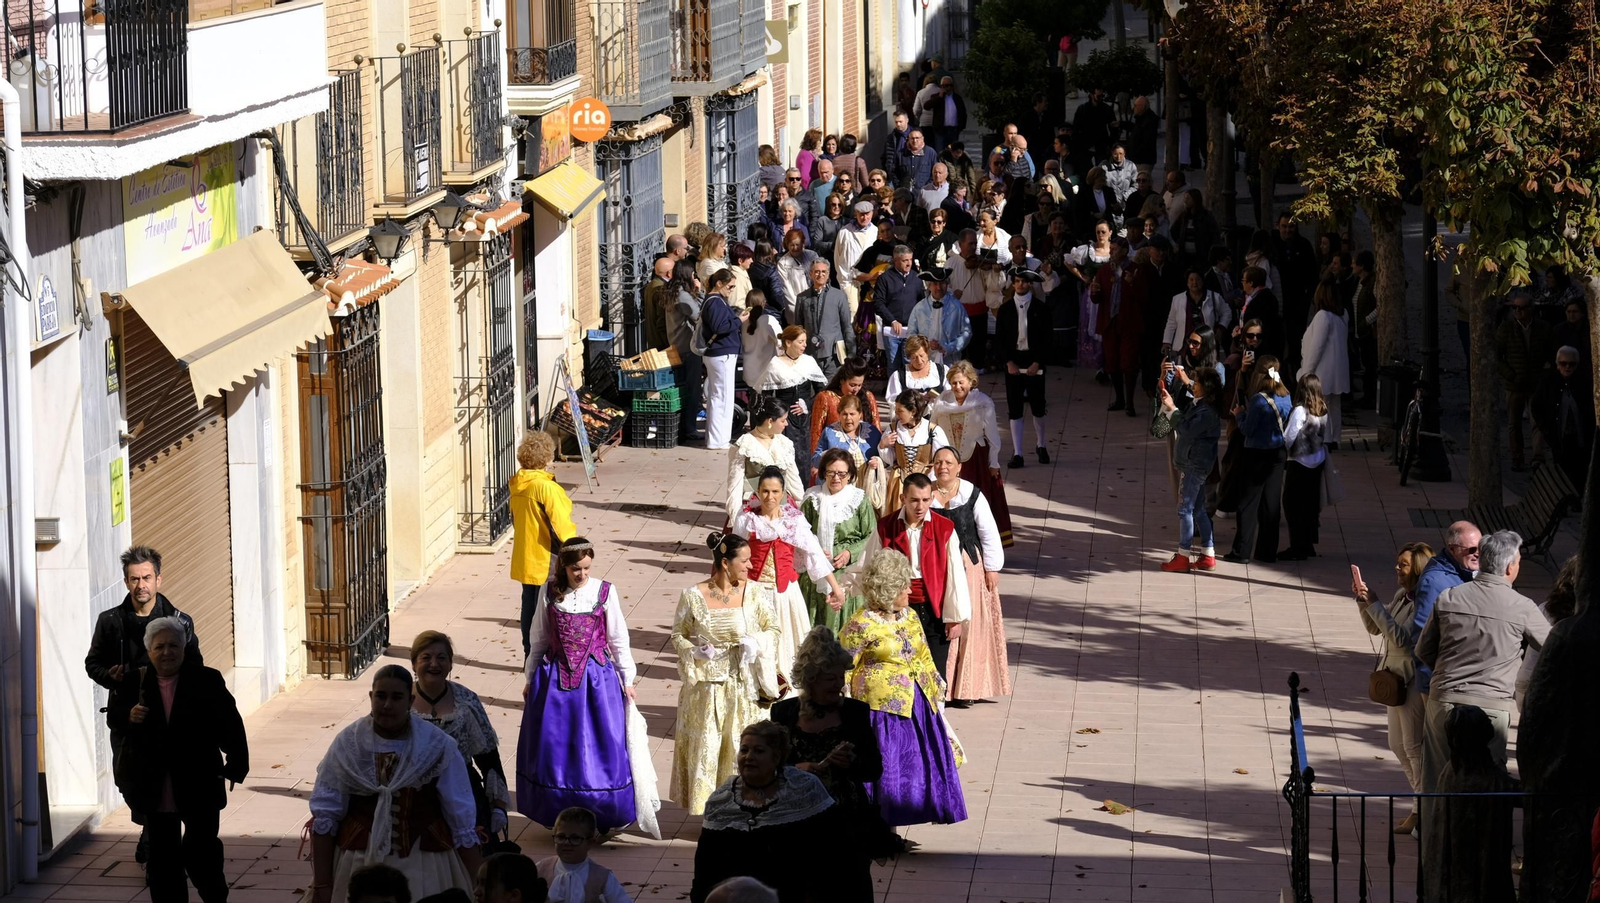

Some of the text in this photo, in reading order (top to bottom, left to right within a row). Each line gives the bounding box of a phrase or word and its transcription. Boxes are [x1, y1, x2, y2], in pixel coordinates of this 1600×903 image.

[573, 103, 605, 125] ria
[129, 173, 151, 206] Centro
[153, 171, 161, 196] de
[181, 208, 212, 251] Ana
